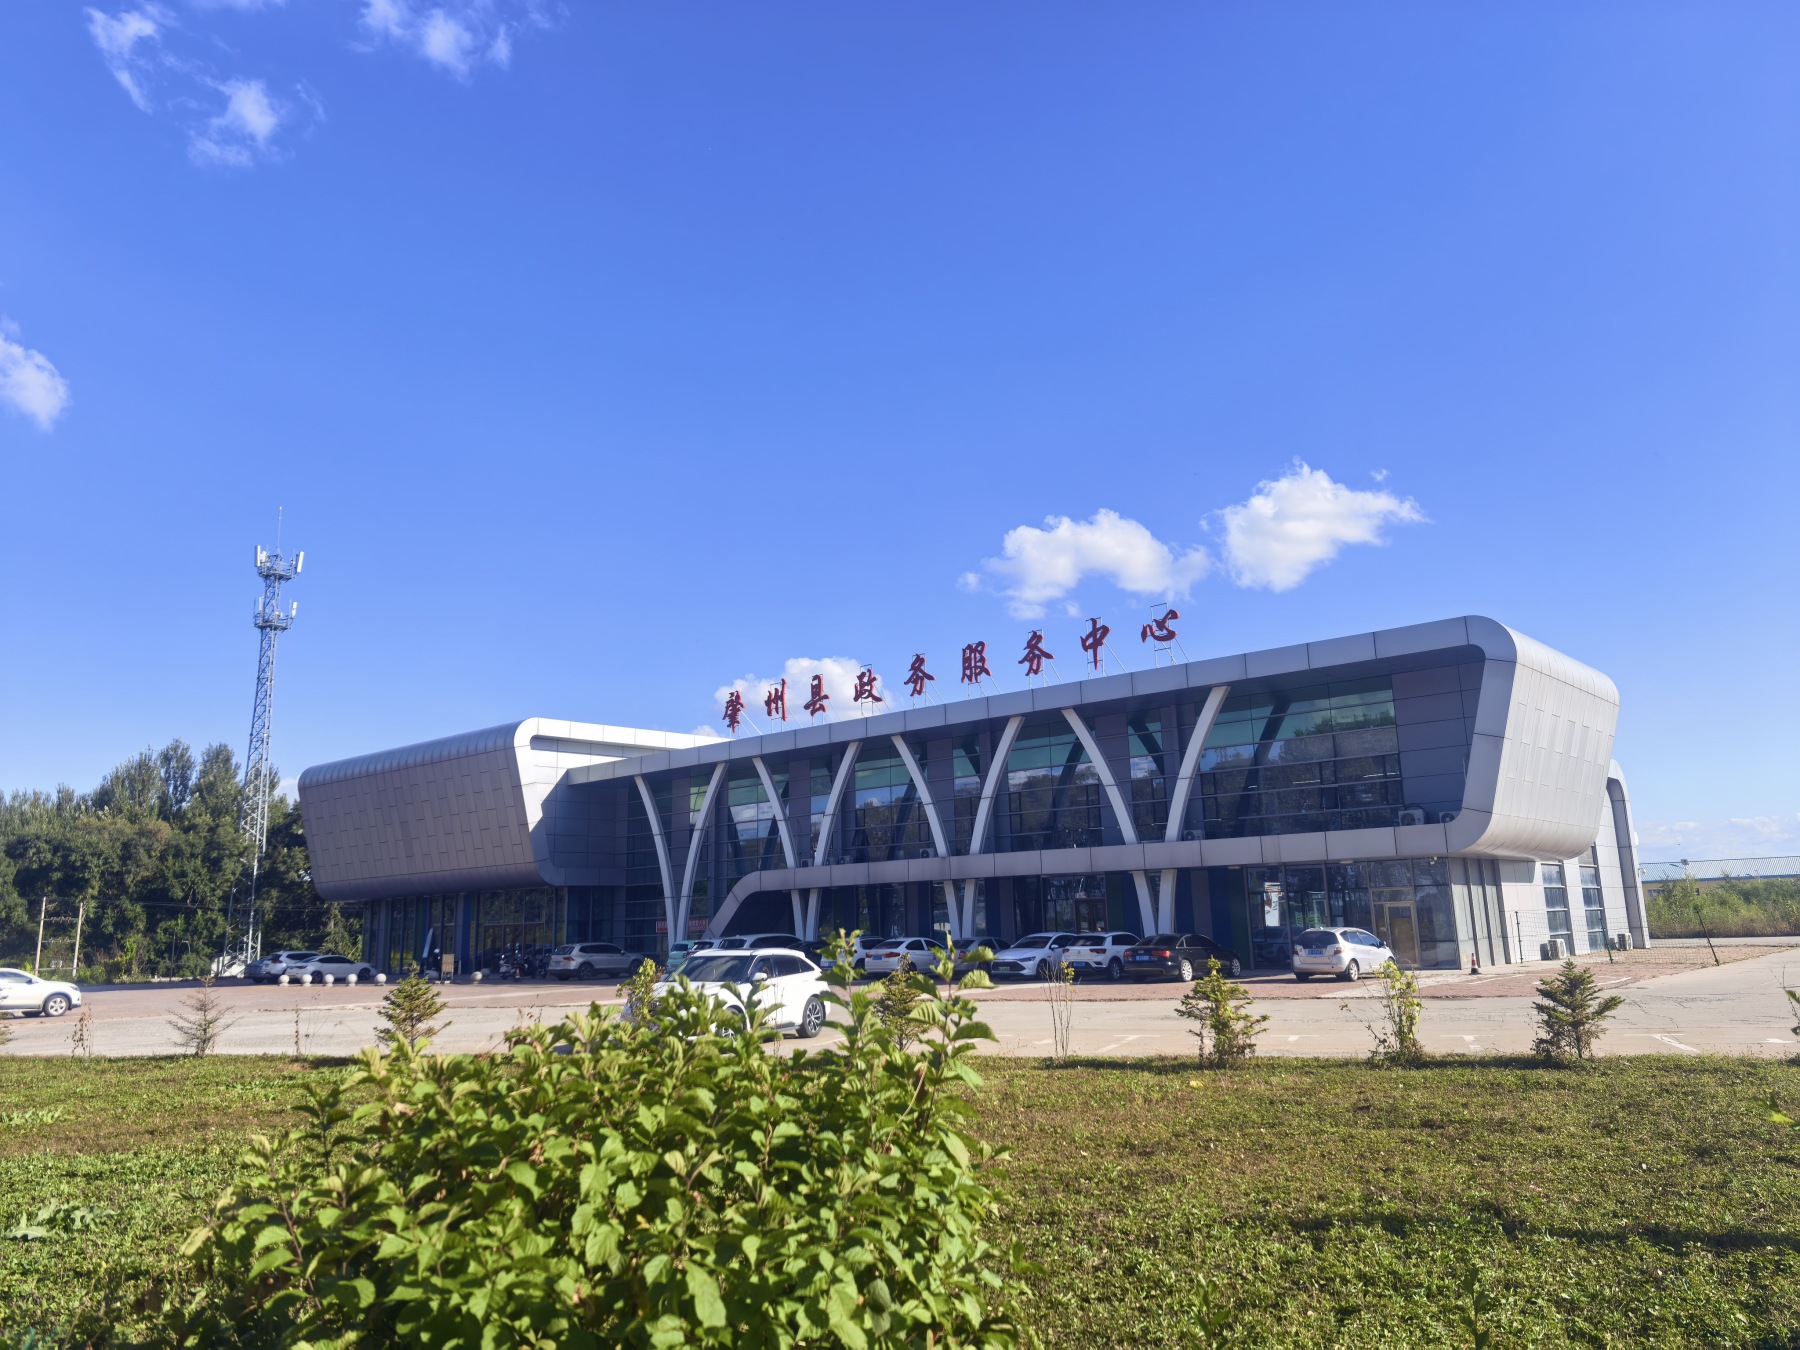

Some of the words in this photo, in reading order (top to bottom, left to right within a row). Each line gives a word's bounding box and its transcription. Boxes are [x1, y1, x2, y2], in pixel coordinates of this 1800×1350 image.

[722, 609, 1180, 732] 肇州县政务服务中心
